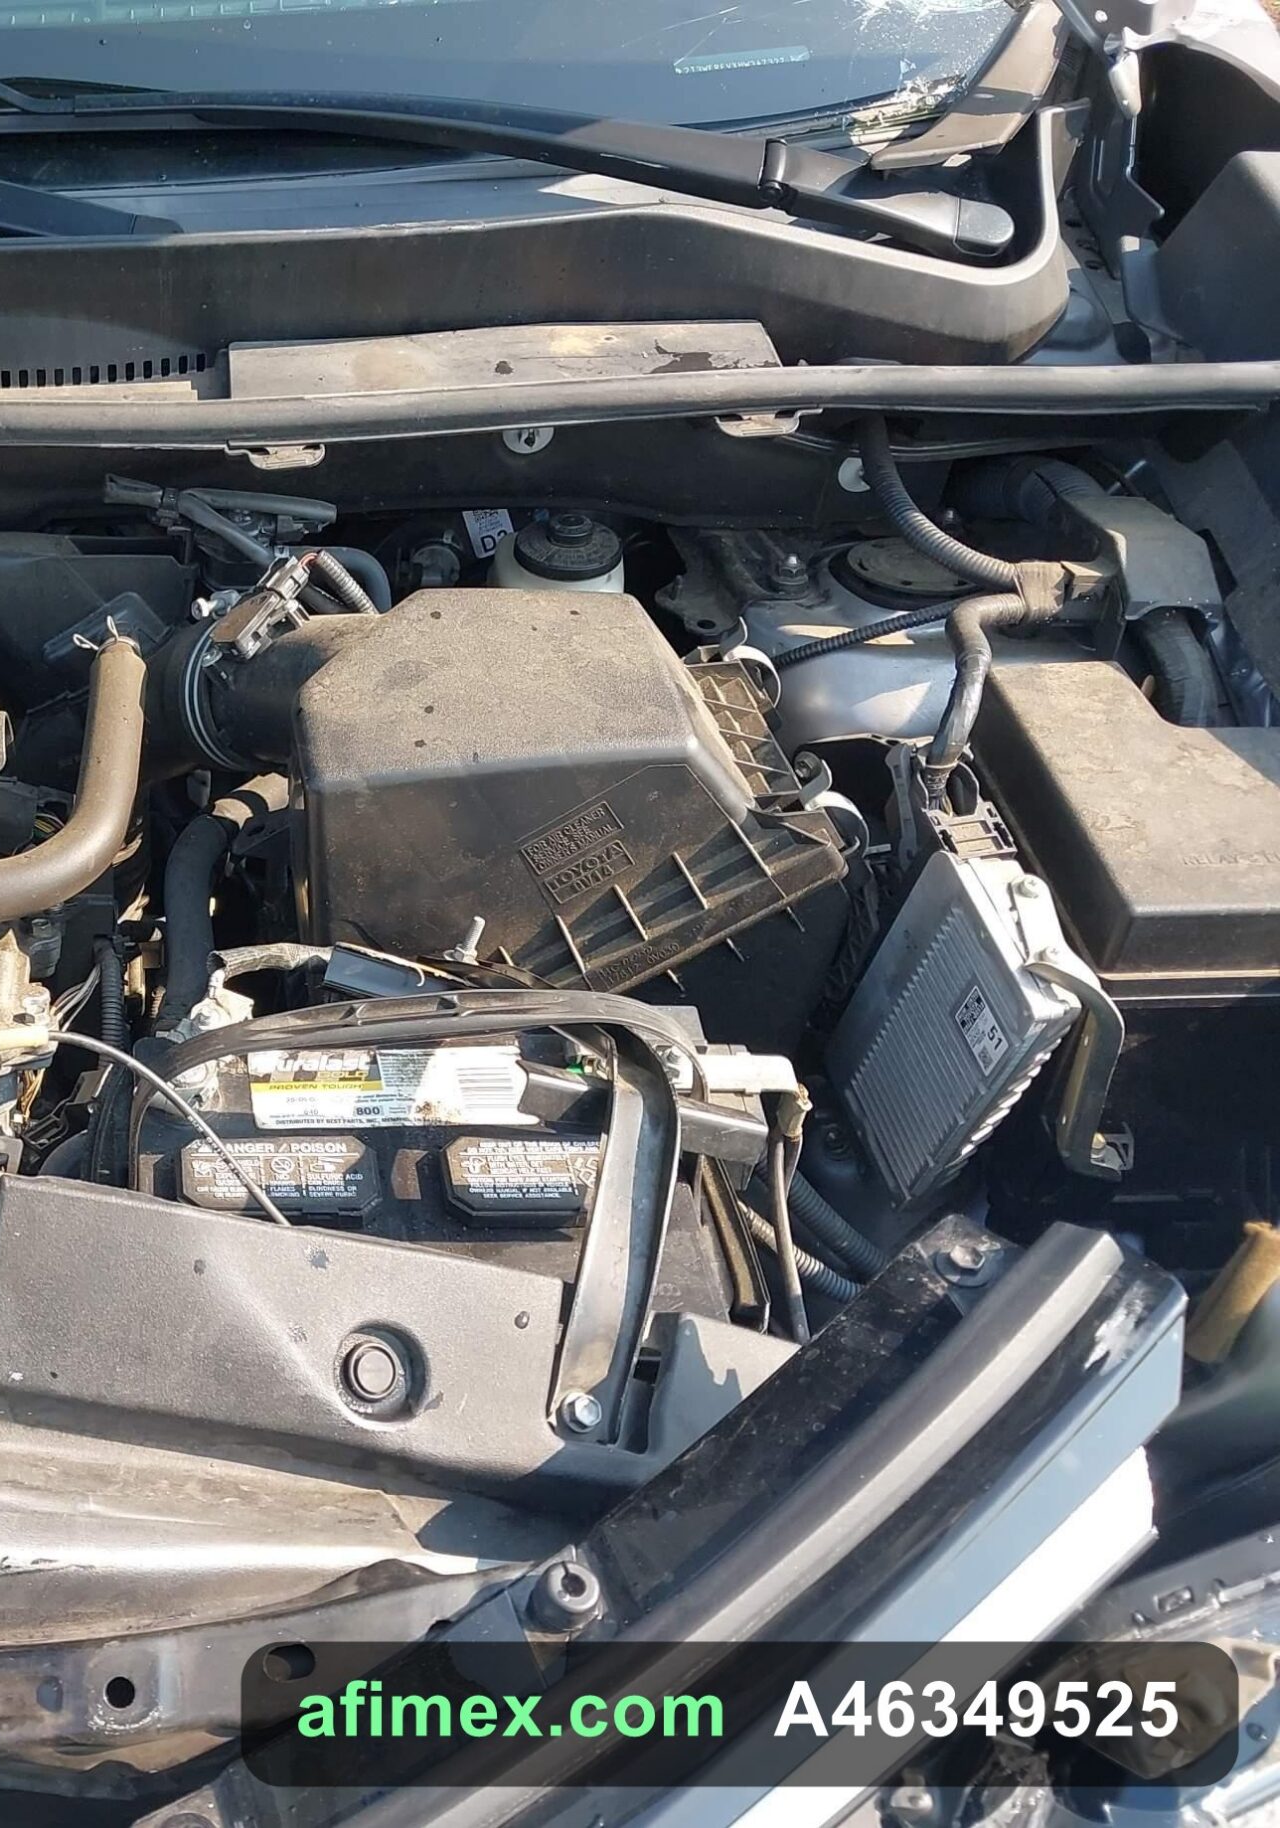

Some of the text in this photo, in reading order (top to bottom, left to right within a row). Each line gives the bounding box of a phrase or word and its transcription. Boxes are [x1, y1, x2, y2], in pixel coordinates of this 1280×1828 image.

[527, 807, 605, 856] FOR AIR CLEANER
[549, 844, 623, 890] TOYOTA
[987, 1025, 1004, 1051] 51
[355, 1106, 381, 1116] 800
[220, 1143, 274, 1153] ANGER
[290, 1143, 347, 1153] POISON
